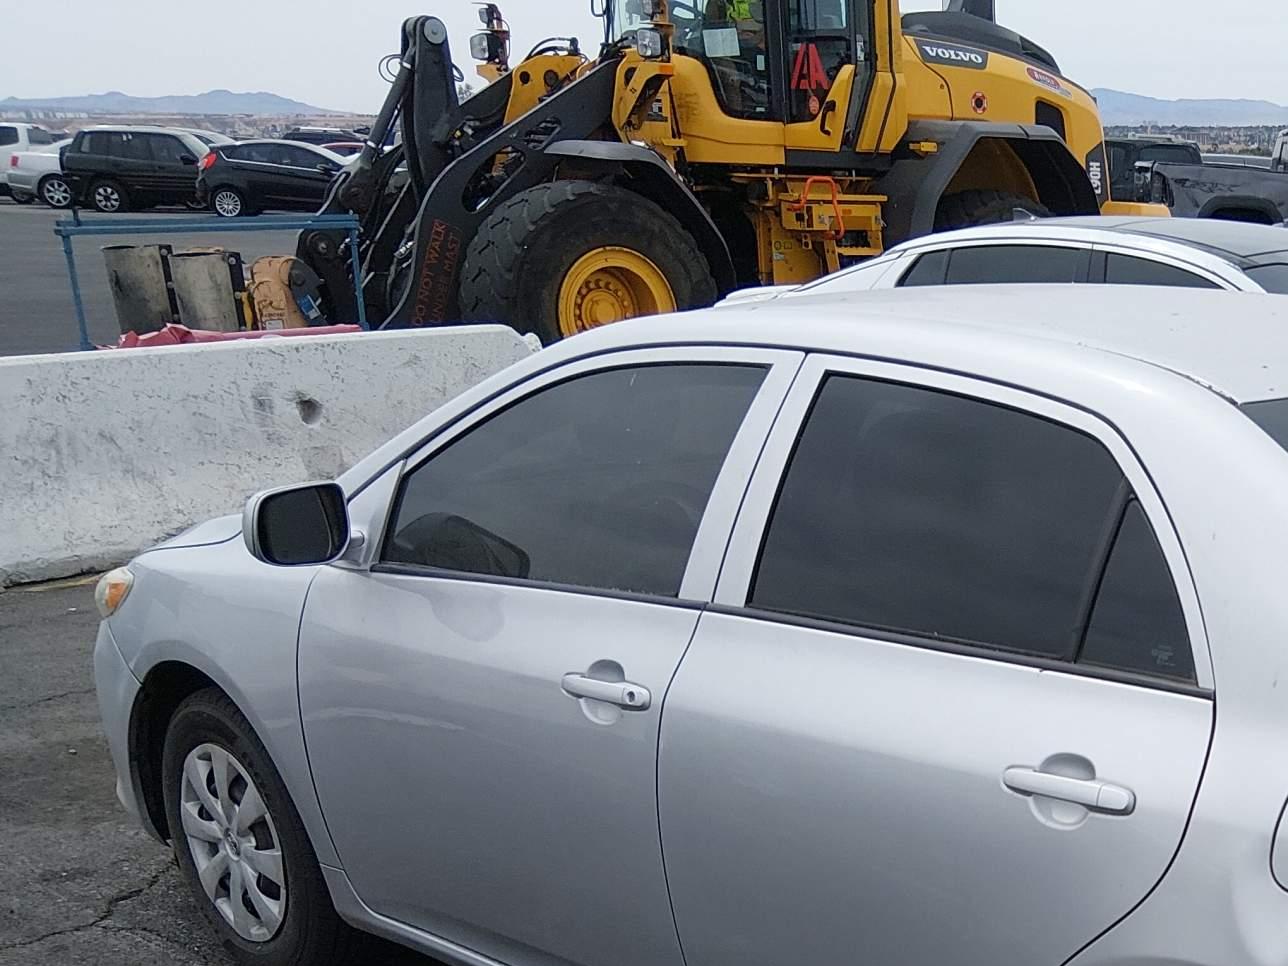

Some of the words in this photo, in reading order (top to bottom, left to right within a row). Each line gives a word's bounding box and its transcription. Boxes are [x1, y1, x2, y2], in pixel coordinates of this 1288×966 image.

[922, 45, 983, 64] VOLVO
[1089, 162, 1102, 195] L90H
[427, 219, 448, 264] WALK
